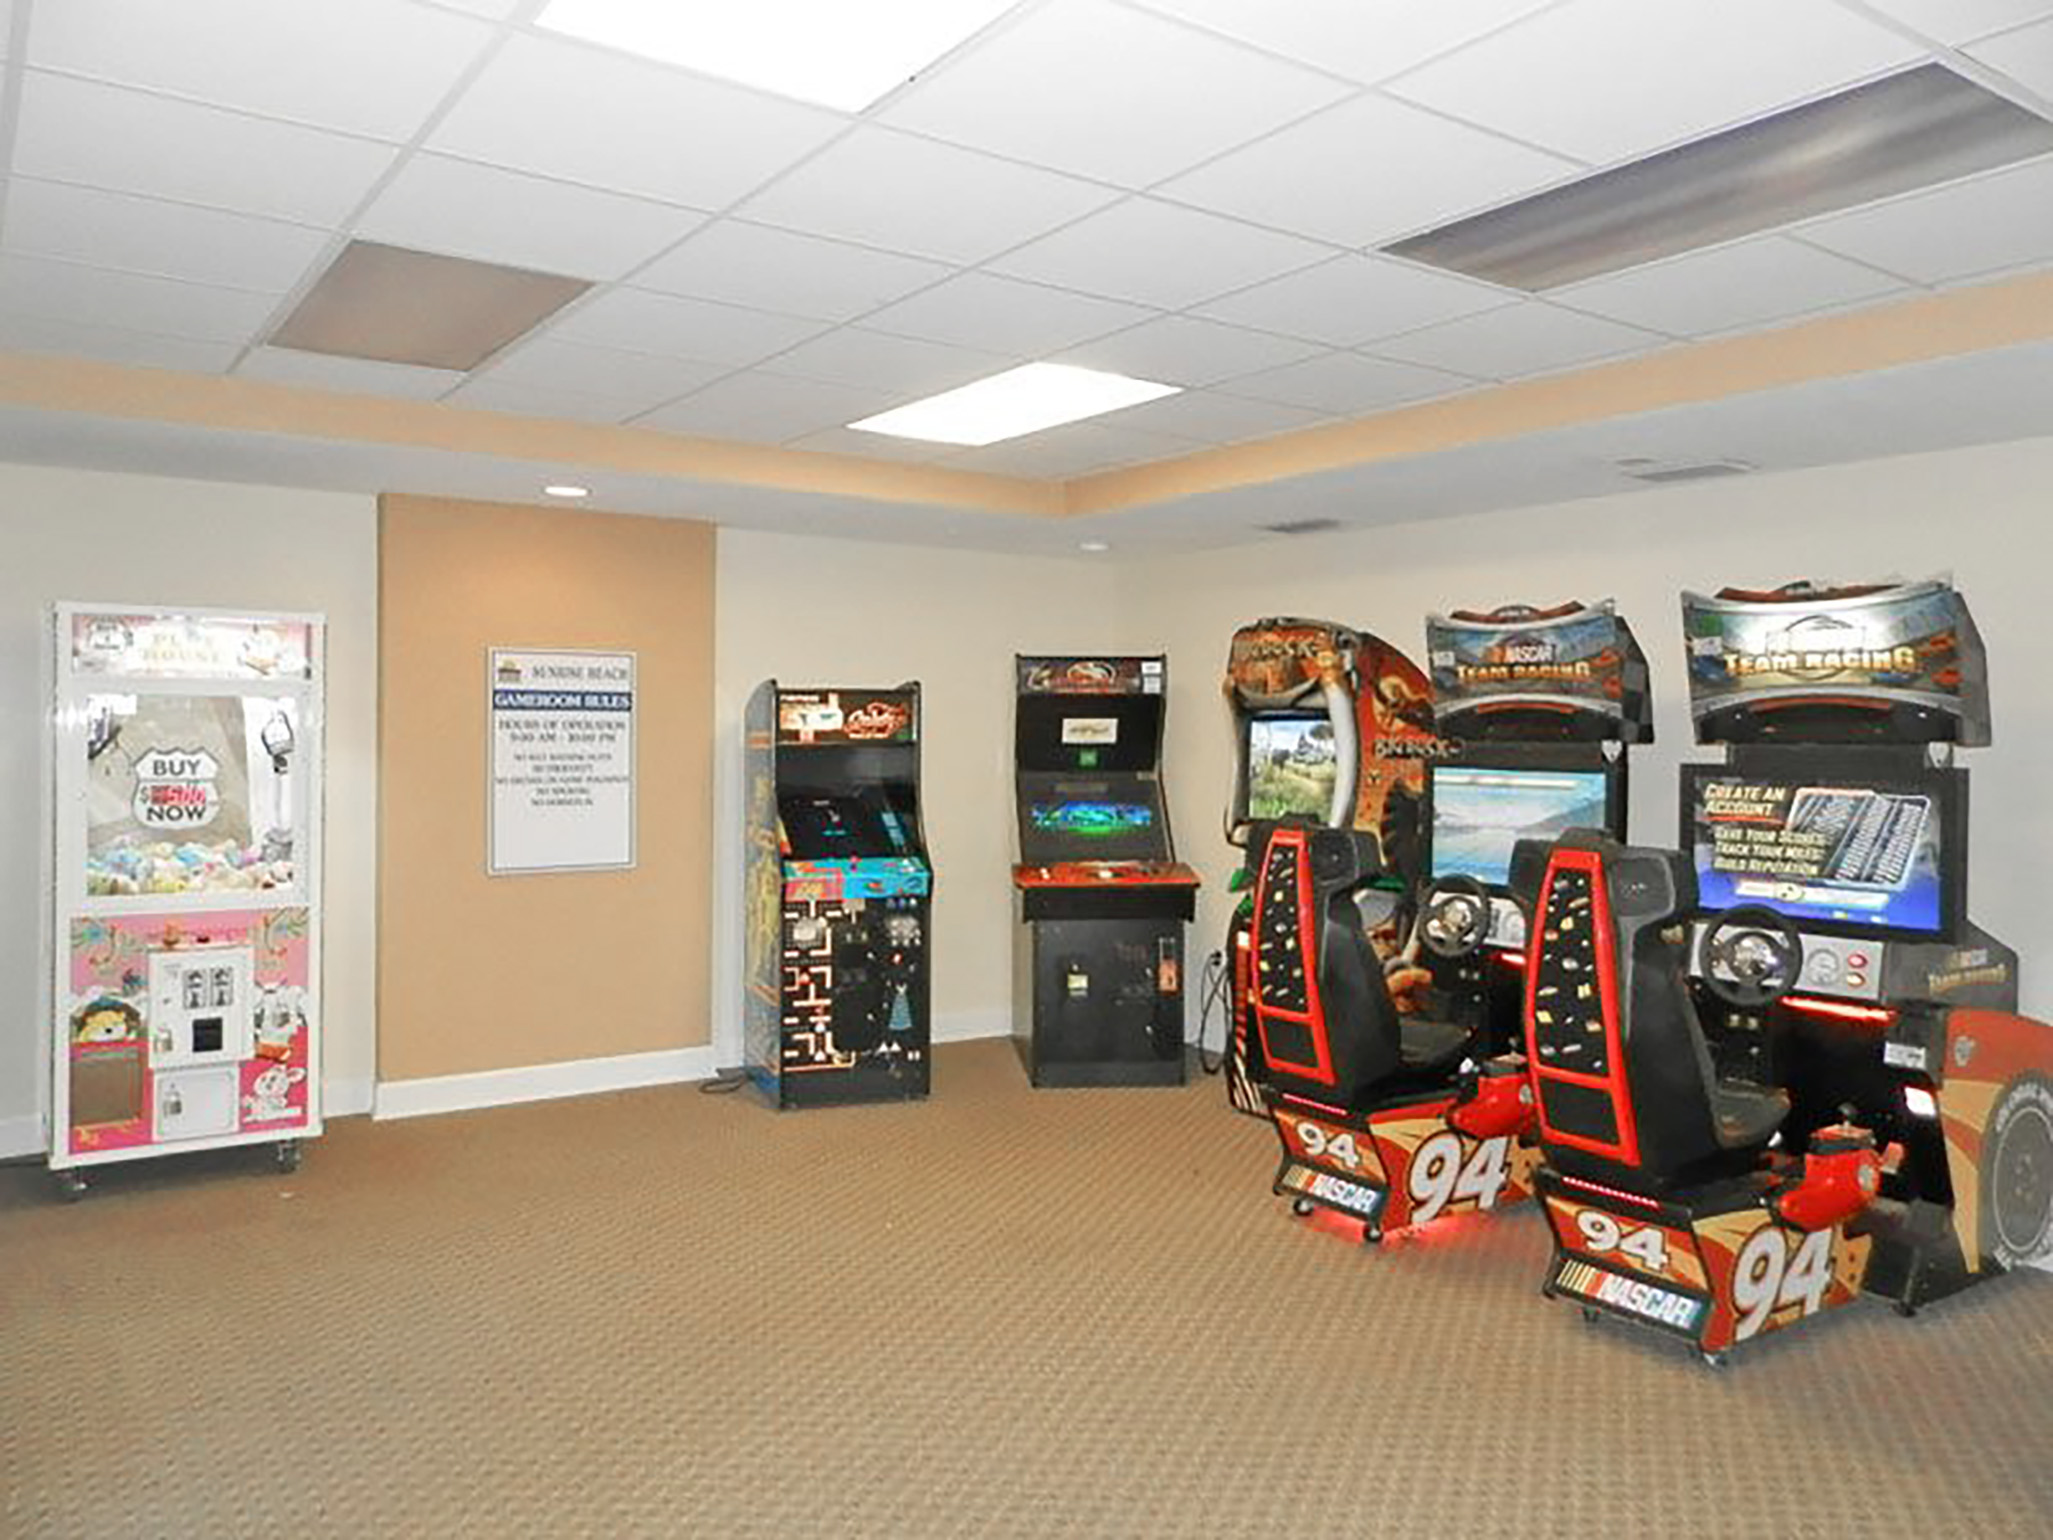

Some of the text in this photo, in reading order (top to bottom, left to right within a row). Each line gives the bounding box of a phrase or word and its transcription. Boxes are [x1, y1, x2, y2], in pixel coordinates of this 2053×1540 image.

[1457, 661, 1591, 679] TEAM RACING
[1724, 646, 1915, 677] TEAM RACING
[584, 694, 630, 708] RULES
[152, 759, 201, 776] BUY
[1704, 783, 1787, 802] CREATE AN
[147, 805, 207, 822] NOW
[1704, 800, 1775, 817] ACCOUNT
[1745, 828, 1777, 843] YOUR
[1714, 841, 1747, 854] TRACK
[1750, 843, 1781, 857] YOUR
[1749, 859, 1819, 876] REPUTATION
[1296, 1121, 1361, 1168] 94
[1409, 1131, 1511, 1223] 94
[1311, 1172, 1380, 1214] NASCAR
[1575, 1210, 1670, 1269] 94
[1732, 1226, 1835, 1341] 94
[1598, 1271, 1697, 1330] NASCAR
